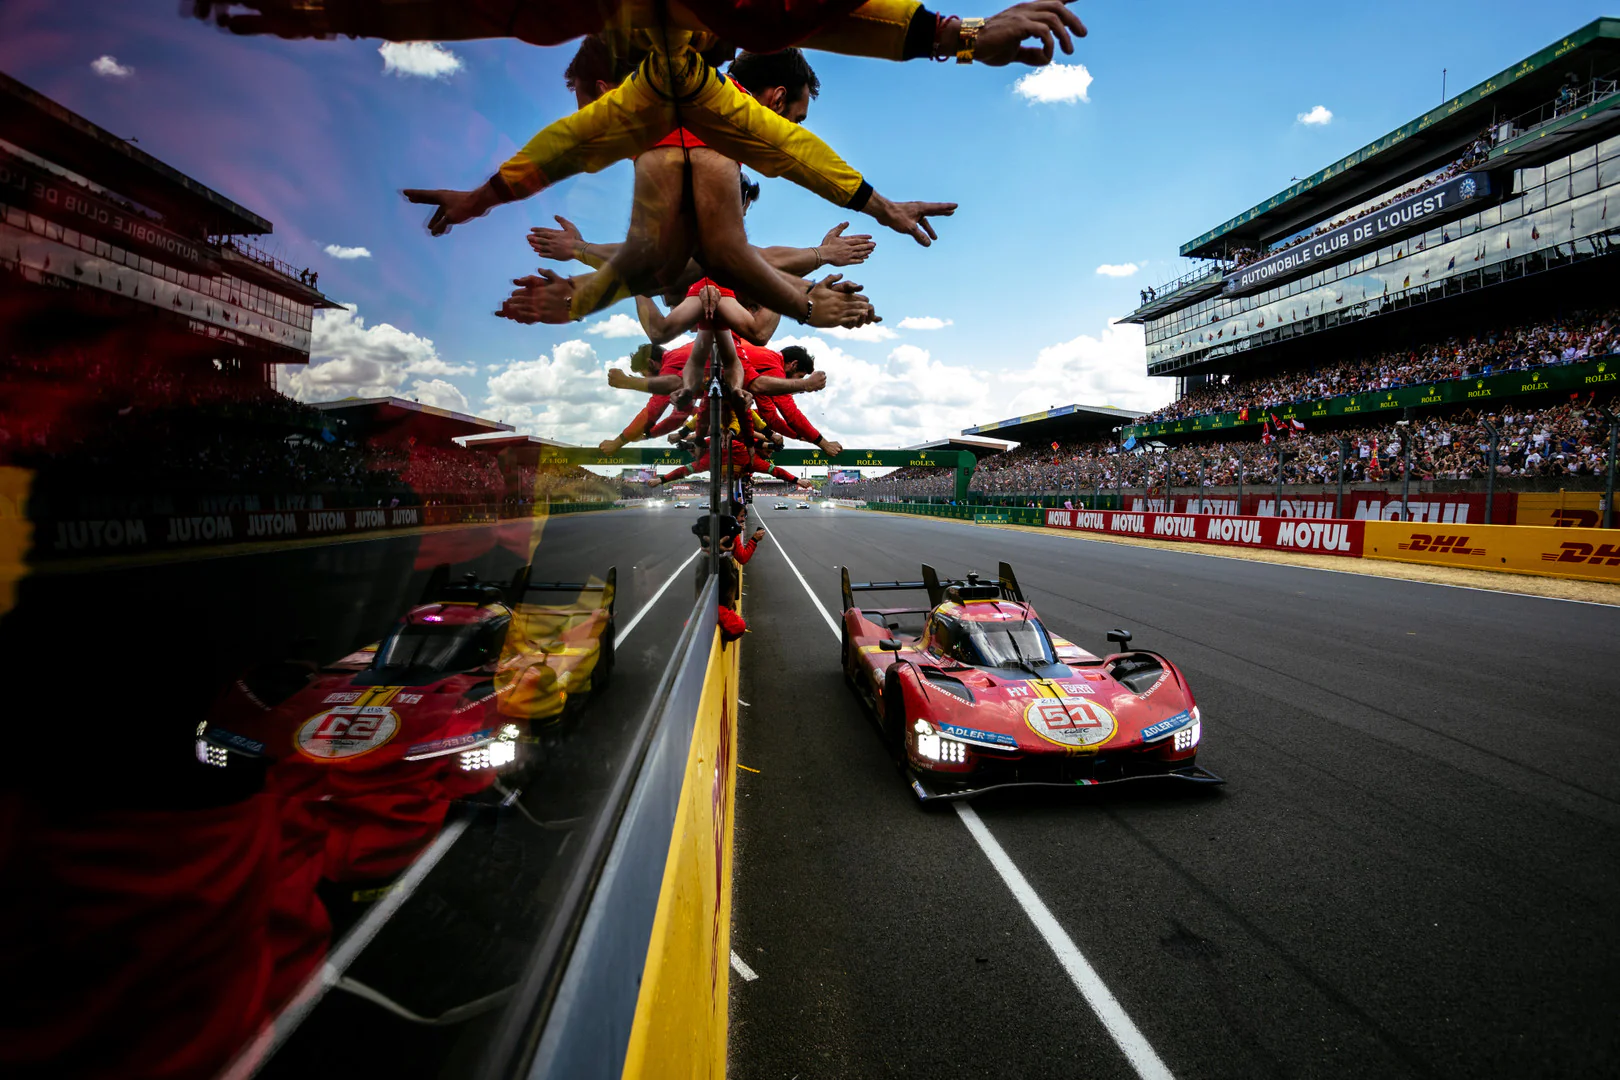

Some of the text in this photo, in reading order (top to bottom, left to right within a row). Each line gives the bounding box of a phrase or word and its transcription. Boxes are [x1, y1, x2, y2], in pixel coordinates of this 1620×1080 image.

[1555, 41, 1576, 57] ROLEX
[1515, 63, 1535, 78] ROLEX
[1241, 191, 1446, 287] AUTOMOBILE CLUB DE L'OUEST
[1585, 372, 1617, 384] ROLEX
[1467, 388, 1491, 398] ROLEX
[1521, 381, 1549, 392] ROLEX
[1380, 401, 1398, 409] ROLEX
[1421, 395, 1442, 404] ROLEX
[1312, 408, 1327, 416] ROLEX
[1344, 405, 1361, 413] ROLEX
[1048, 510, 1071, 527] MOTUL
[1076, 512, 1104, 530] MOTUL
[1111, 513, 1145, 533] MOTUL
[1153, 515, 1196, 538] MOTUL
[1207, 518, 1262, 544] MOTUL
[1276, 521, 1351, 551] MOTUL
[1408, 534, 1473, 555] DHL
[1557, 542, 1620, 567] DH
[1159, 669, 1171, 685] MILLE
[920, 679, 976, 708] RICHARD MILLE
[1006, 686, 1029, 697] HY
[1042, 706, 1098, 727] 51
[946, 726, 985, 740] ADLER
[1143, 720, 1174, 738] ADLER
